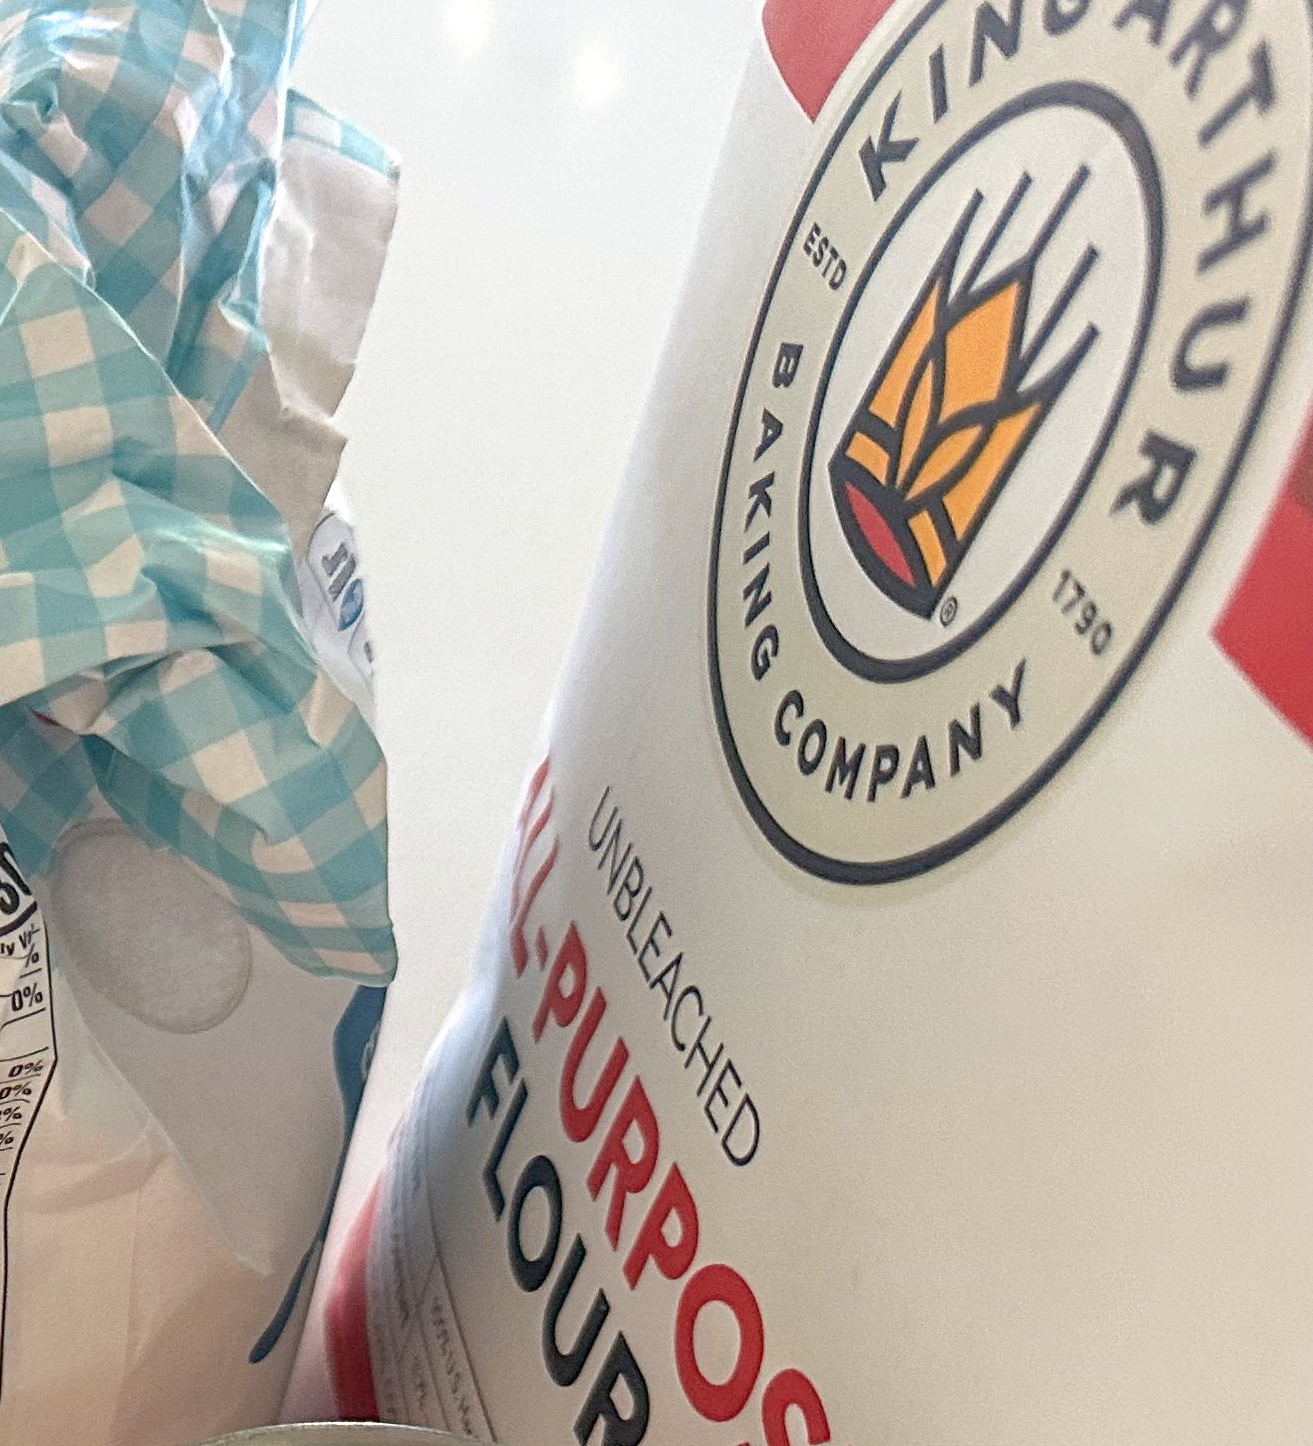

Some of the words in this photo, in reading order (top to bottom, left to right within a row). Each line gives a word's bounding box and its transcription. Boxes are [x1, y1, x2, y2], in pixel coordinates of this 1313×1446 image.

[803, 221, 848, 292] ESTD
[743, 341, 806, 682] BAKING
[776, 660, 1027, 803] COMPANY
[1054, 568, 1112, 658] 1790
[589, 786, 760, 1169] UNBLEACHED
